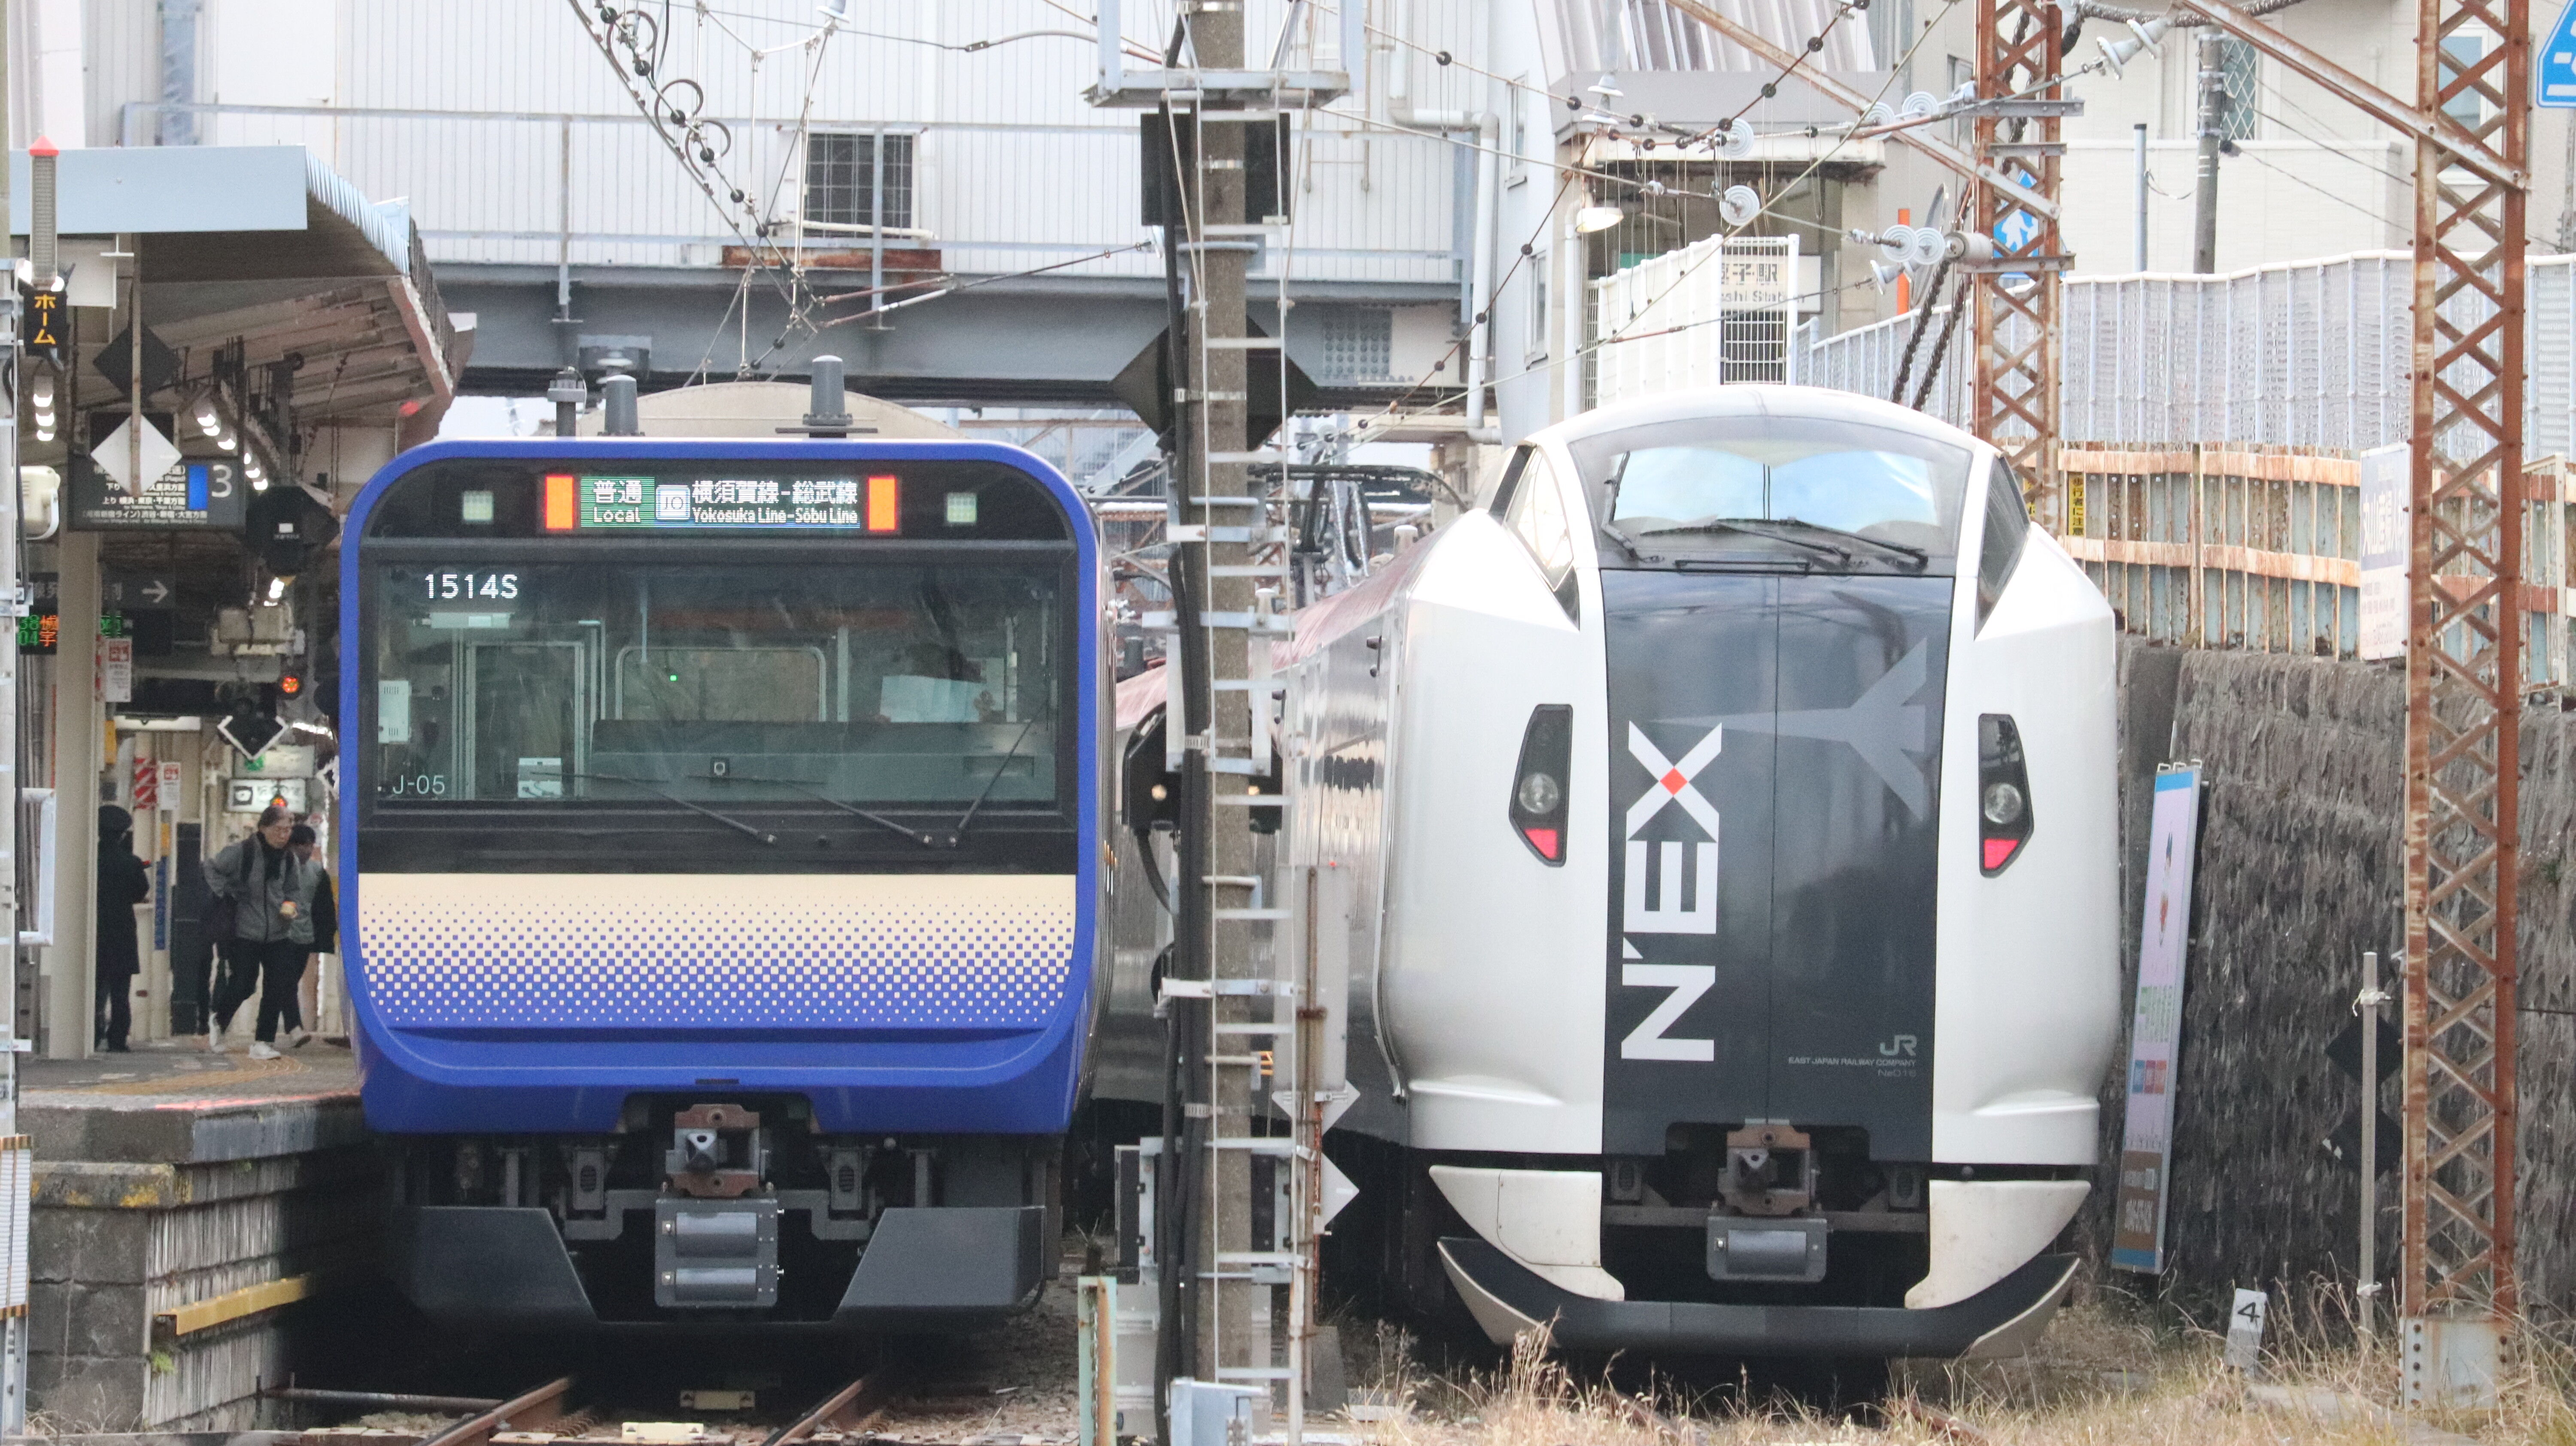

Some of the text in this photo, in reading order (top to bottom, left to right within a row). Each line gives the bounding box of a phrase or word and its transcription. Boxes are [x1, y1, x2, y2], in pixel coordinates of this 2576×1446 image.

[34, 294, 56, 345] ホーム
[212, 465, 232, 498] 3
[593, 480, 642, 503] 普通
[665, 497, 683, 510] JO
[593, 507, 641, 522] Local
[692, 507, 756, 523] Yokosuka
[829, 507, 857, 523] Line
[425, 574, 518, 598] 1514S
[393, 775, 445, 795] J-05
[1880, 1034, 1917, 1056] JR
[1811, 1057, 1839, 1065] JAPAN
[1840, 1058, 1875, 1066] RAILWAY
[1876, 1059, 1917, 1067] COMPANY
[2238, 1302, 2260, 1322] 4
